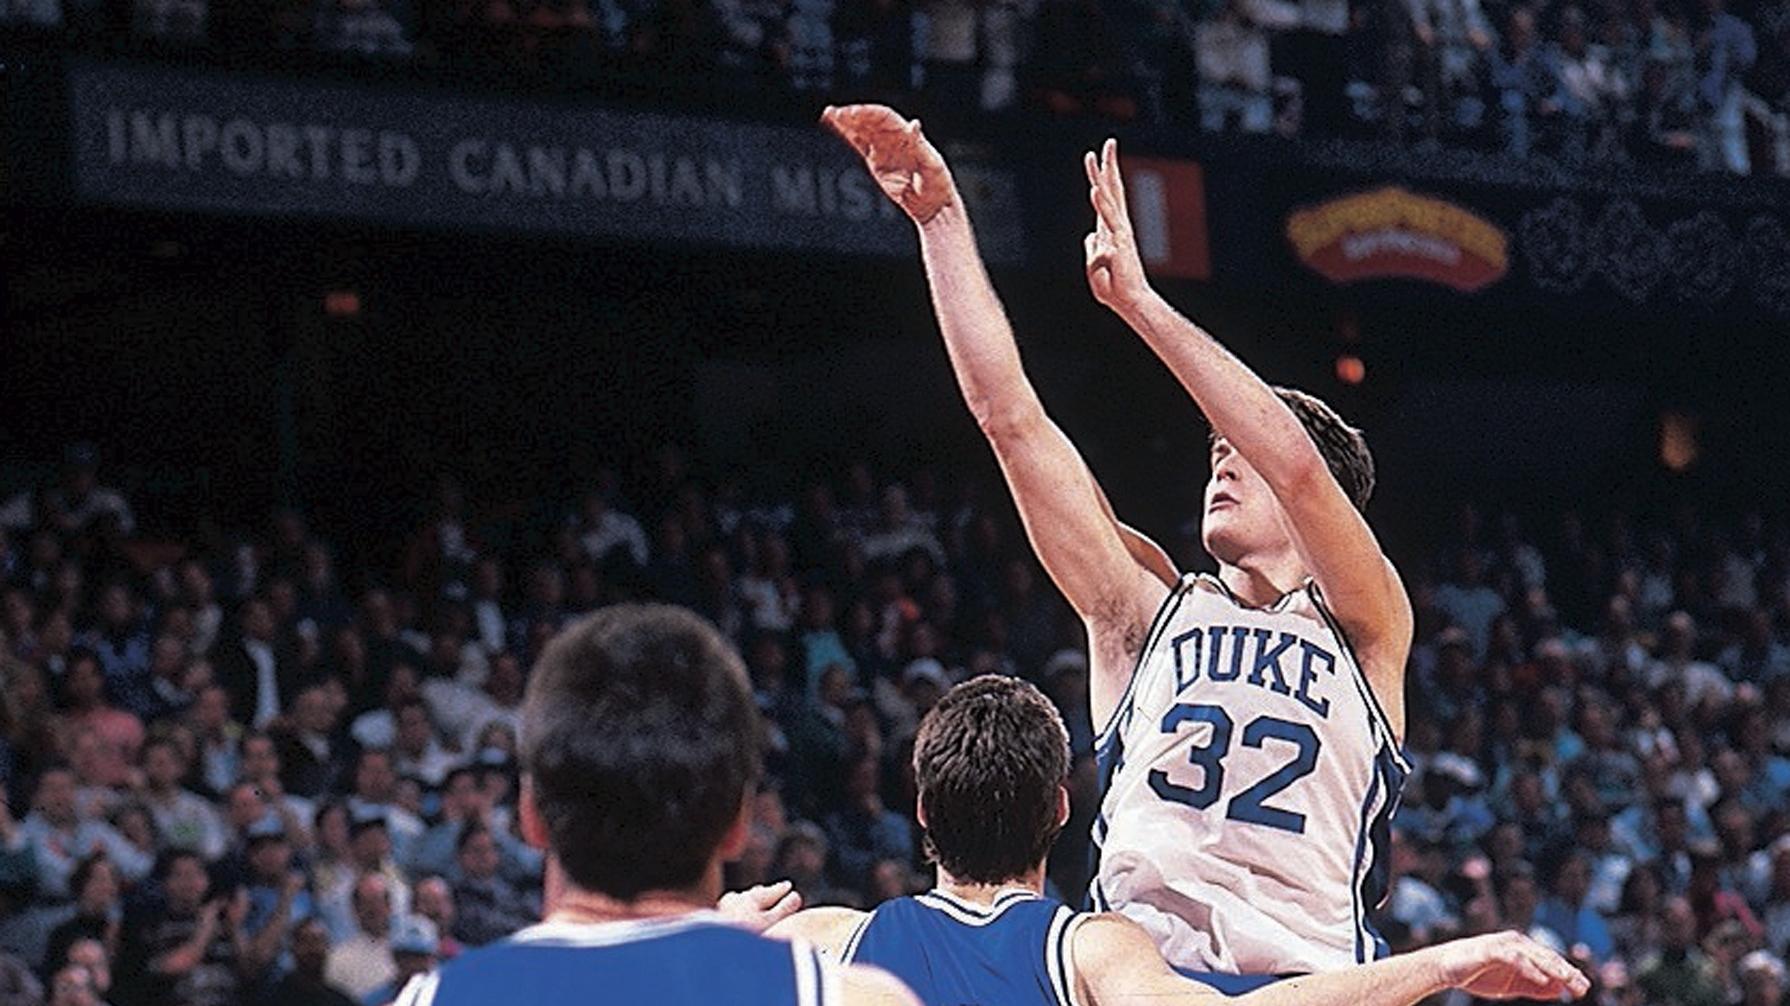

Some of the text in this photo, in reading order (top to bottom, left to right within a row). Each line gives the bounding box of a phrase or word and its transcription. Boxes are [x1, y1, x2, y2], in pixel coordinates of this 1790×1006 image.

[106, 109, 421, 188] IMPORTED
[448, 138, 741, 206] CANADIAN
[1171, 626, 1336, 719] DUKE
[1147, 702, 1322, 835] 32
